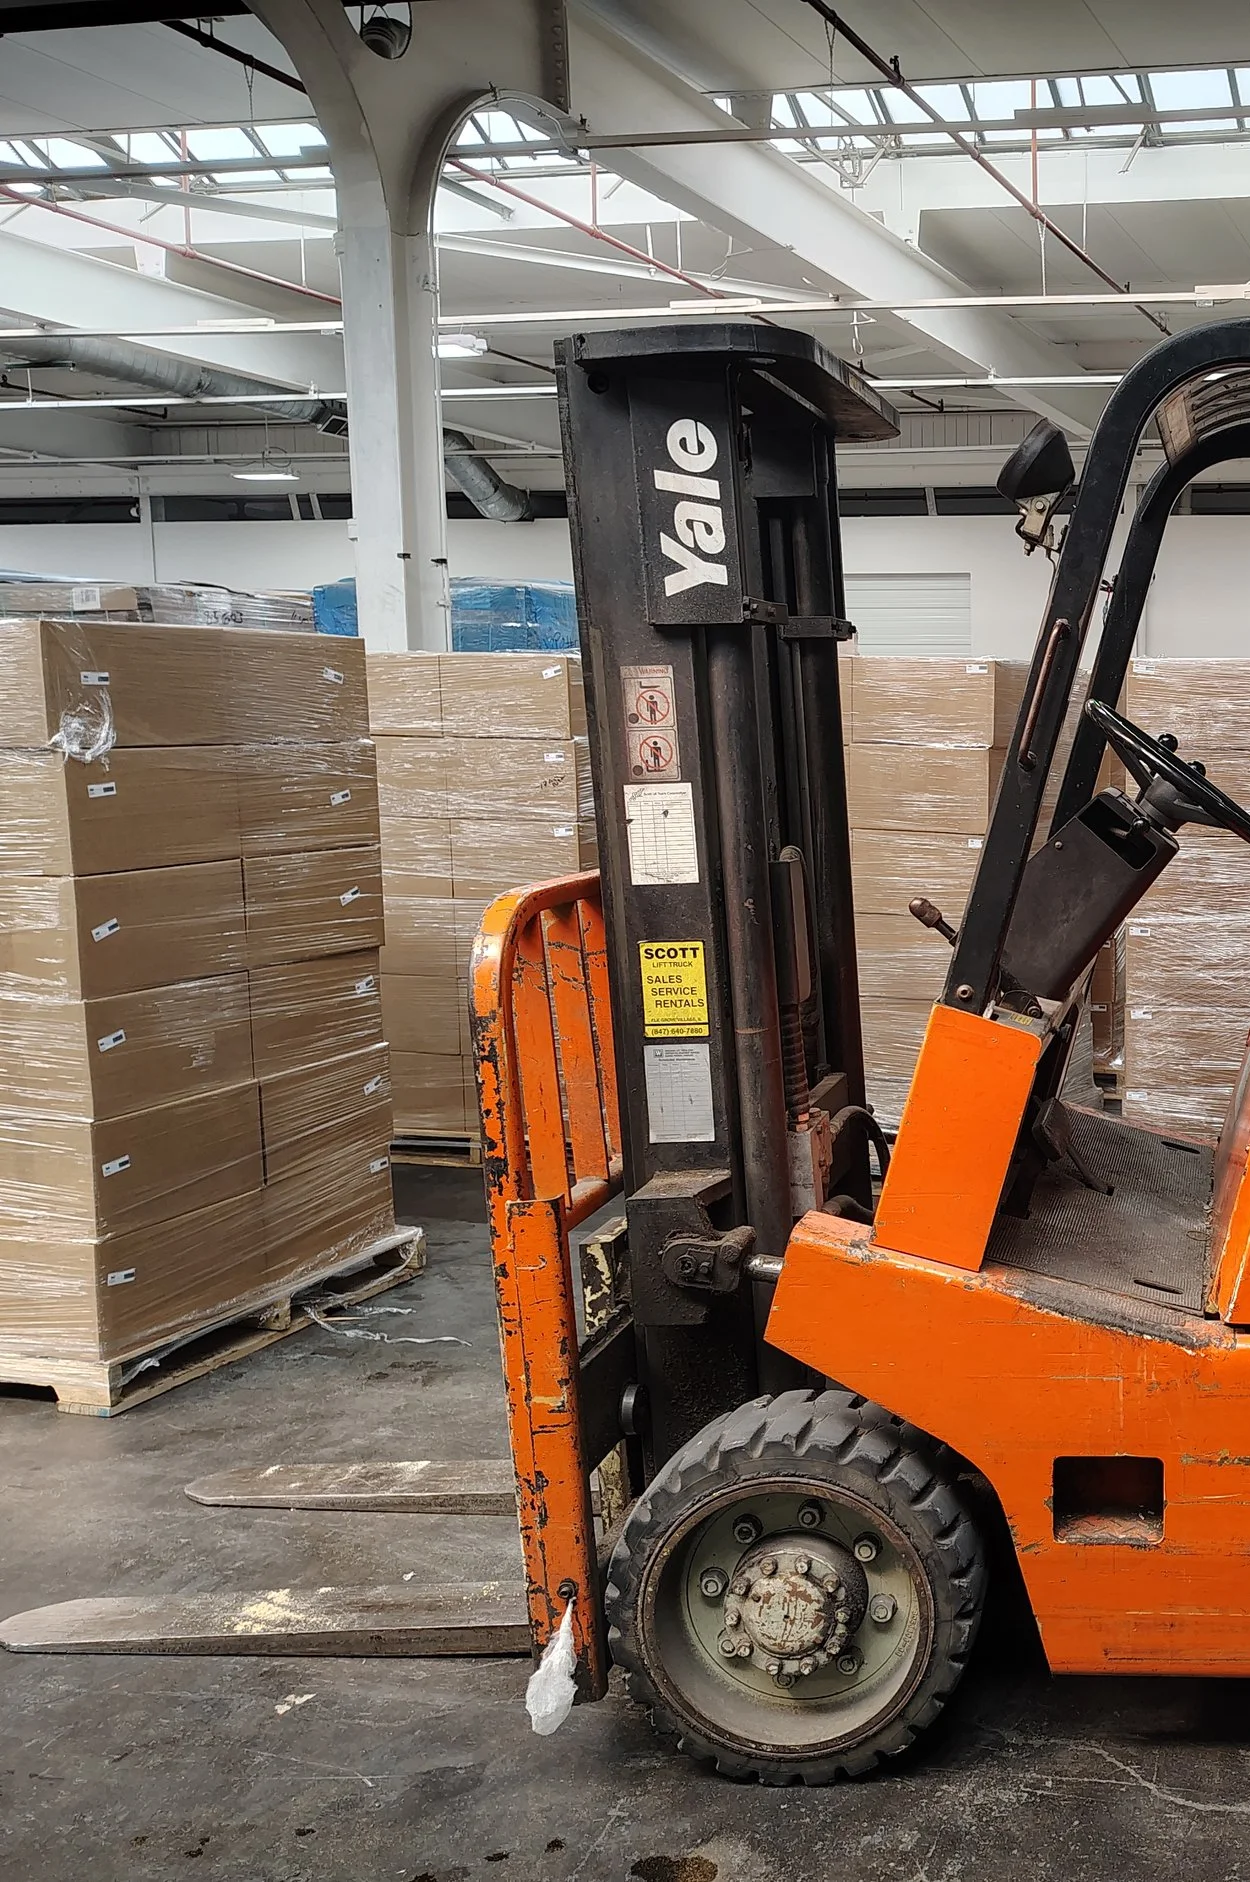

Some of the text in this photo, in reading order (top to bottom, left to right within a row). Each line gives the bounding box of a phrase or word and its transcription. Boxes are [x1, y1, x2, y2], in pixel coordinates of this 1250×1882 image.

[653, 418, 729, 597] Yale
[644, 947, 700, 960] SCOTT
[646, 975, 683, 985] SALES
[651, 986, 698, 996] SERVICE
[655, 999, 705, 1008] RENTALS
[651, 1028, 670, 1036] (847)
